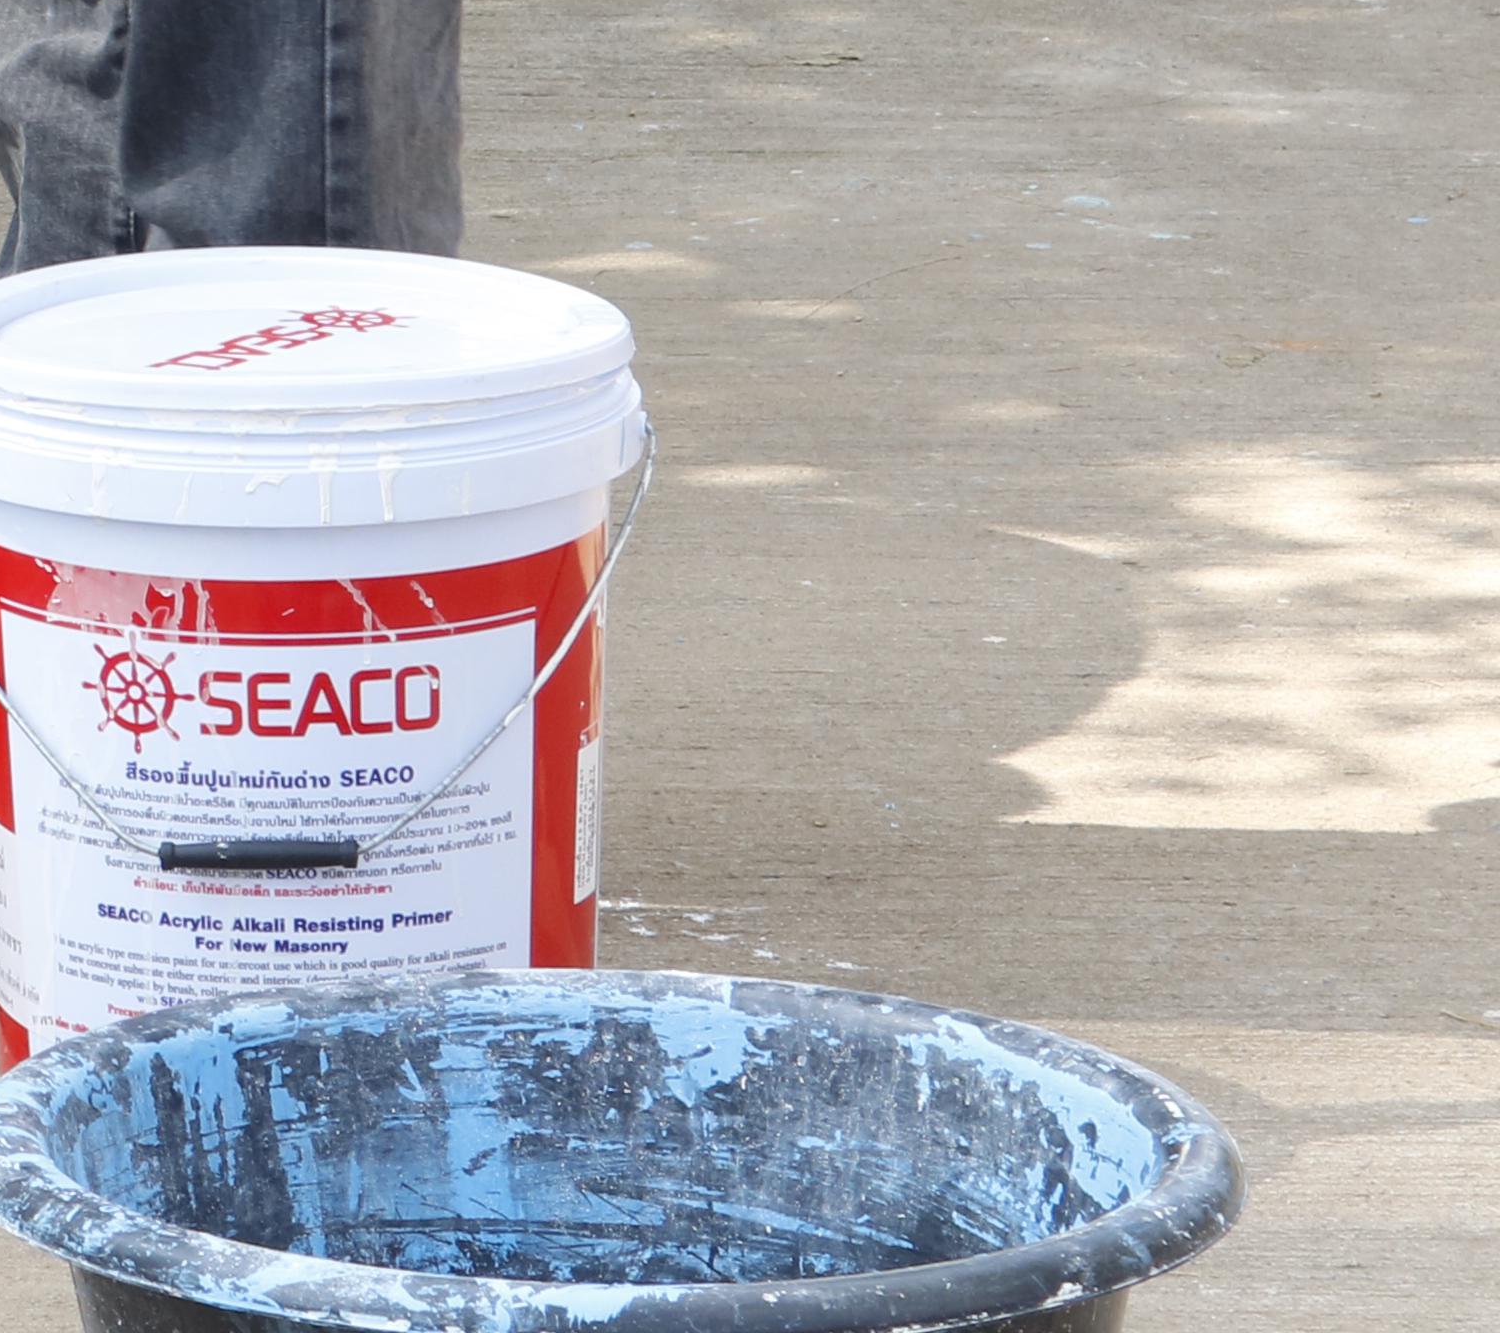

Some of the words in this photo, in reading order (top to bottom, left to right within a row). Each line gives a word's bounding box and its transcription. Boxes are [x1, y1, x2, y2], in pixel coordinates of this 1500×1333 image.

[200, 665, 440, 737] SEACO
[340, 765, 414, 787] SEACO
[267, 868, 316, 880] SEACO
[97, 903, 153, 925] SEACO
[159, 912, 223, 932] Acrylic
[232, 917, 285, 933] Alkali
[293, 915, 384, 933] Resisting
[392, 909, 453, 928] Primer
[195, 936, 222, 951] For
[230, 938, 267, 952] New
[274, 940, 348, 955] Masonry
[106, 946, 125, 961] type
[173, 955, 198, 970] paint
[201, 955, 215, 968] for
[273, 962, 292, 971] use
[294, 959, 326, 971] which
[329, 959, 338, 970] is
[341, 958, 367, 971] good
[370, 955, 404, 970] quality
[407, 953, 421, 965] for
[424, 949, 450, 963] alkali
[167, 968, 194, 981] either
[241, 972, 260, 984] and
[153, 979, 165, 995] by
[168, 984, 198, 998] brush,
